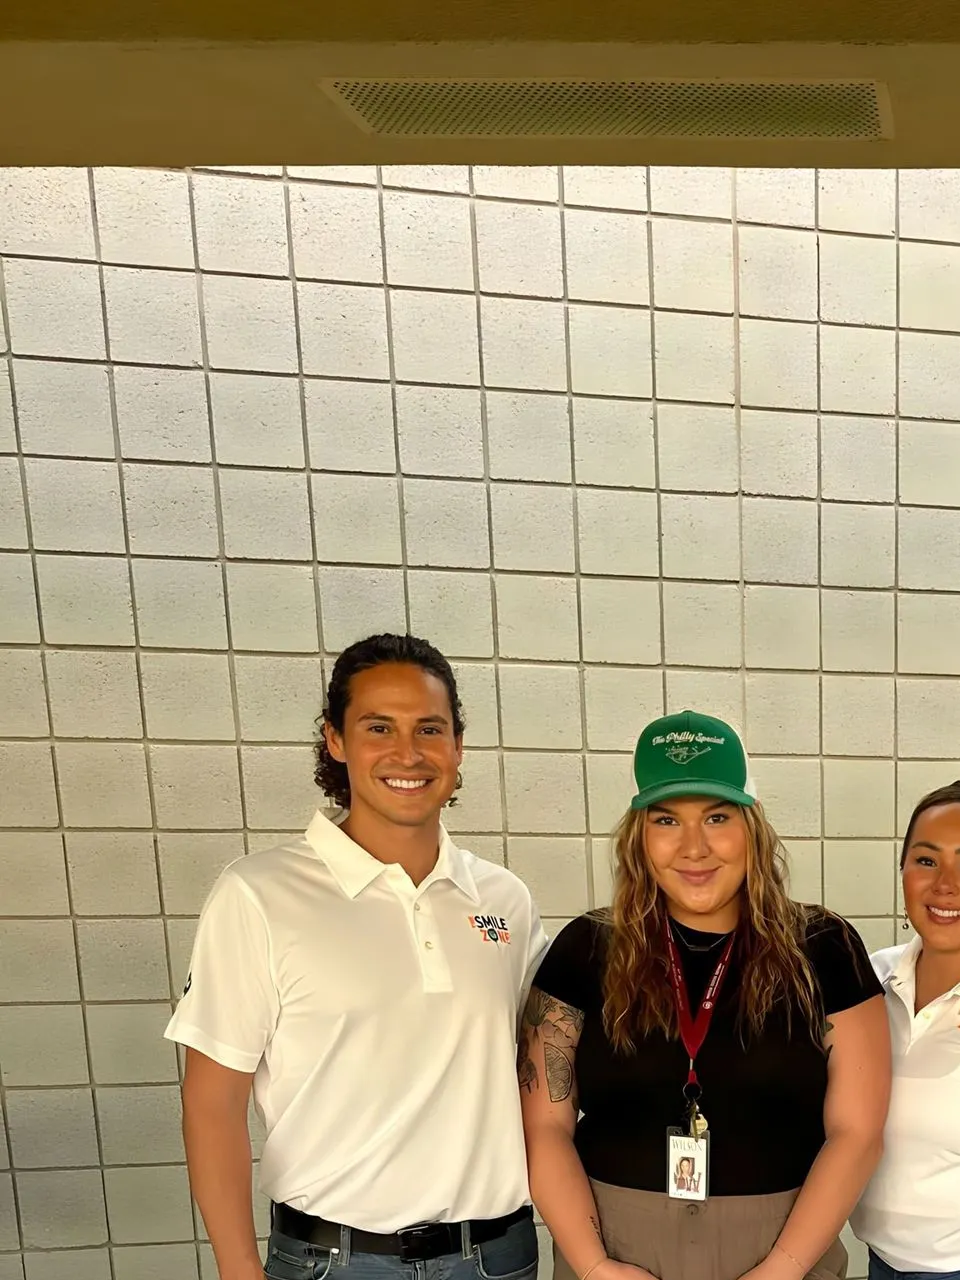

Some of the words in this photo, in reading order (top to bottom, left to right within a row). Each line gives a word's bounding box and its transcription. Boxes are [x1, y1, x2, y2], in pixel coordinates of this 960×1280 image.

[666, 731, 695, 744] Philly
[474, 915, 508, 930] SMILE
[479, 927, 512, 944] ZONE
